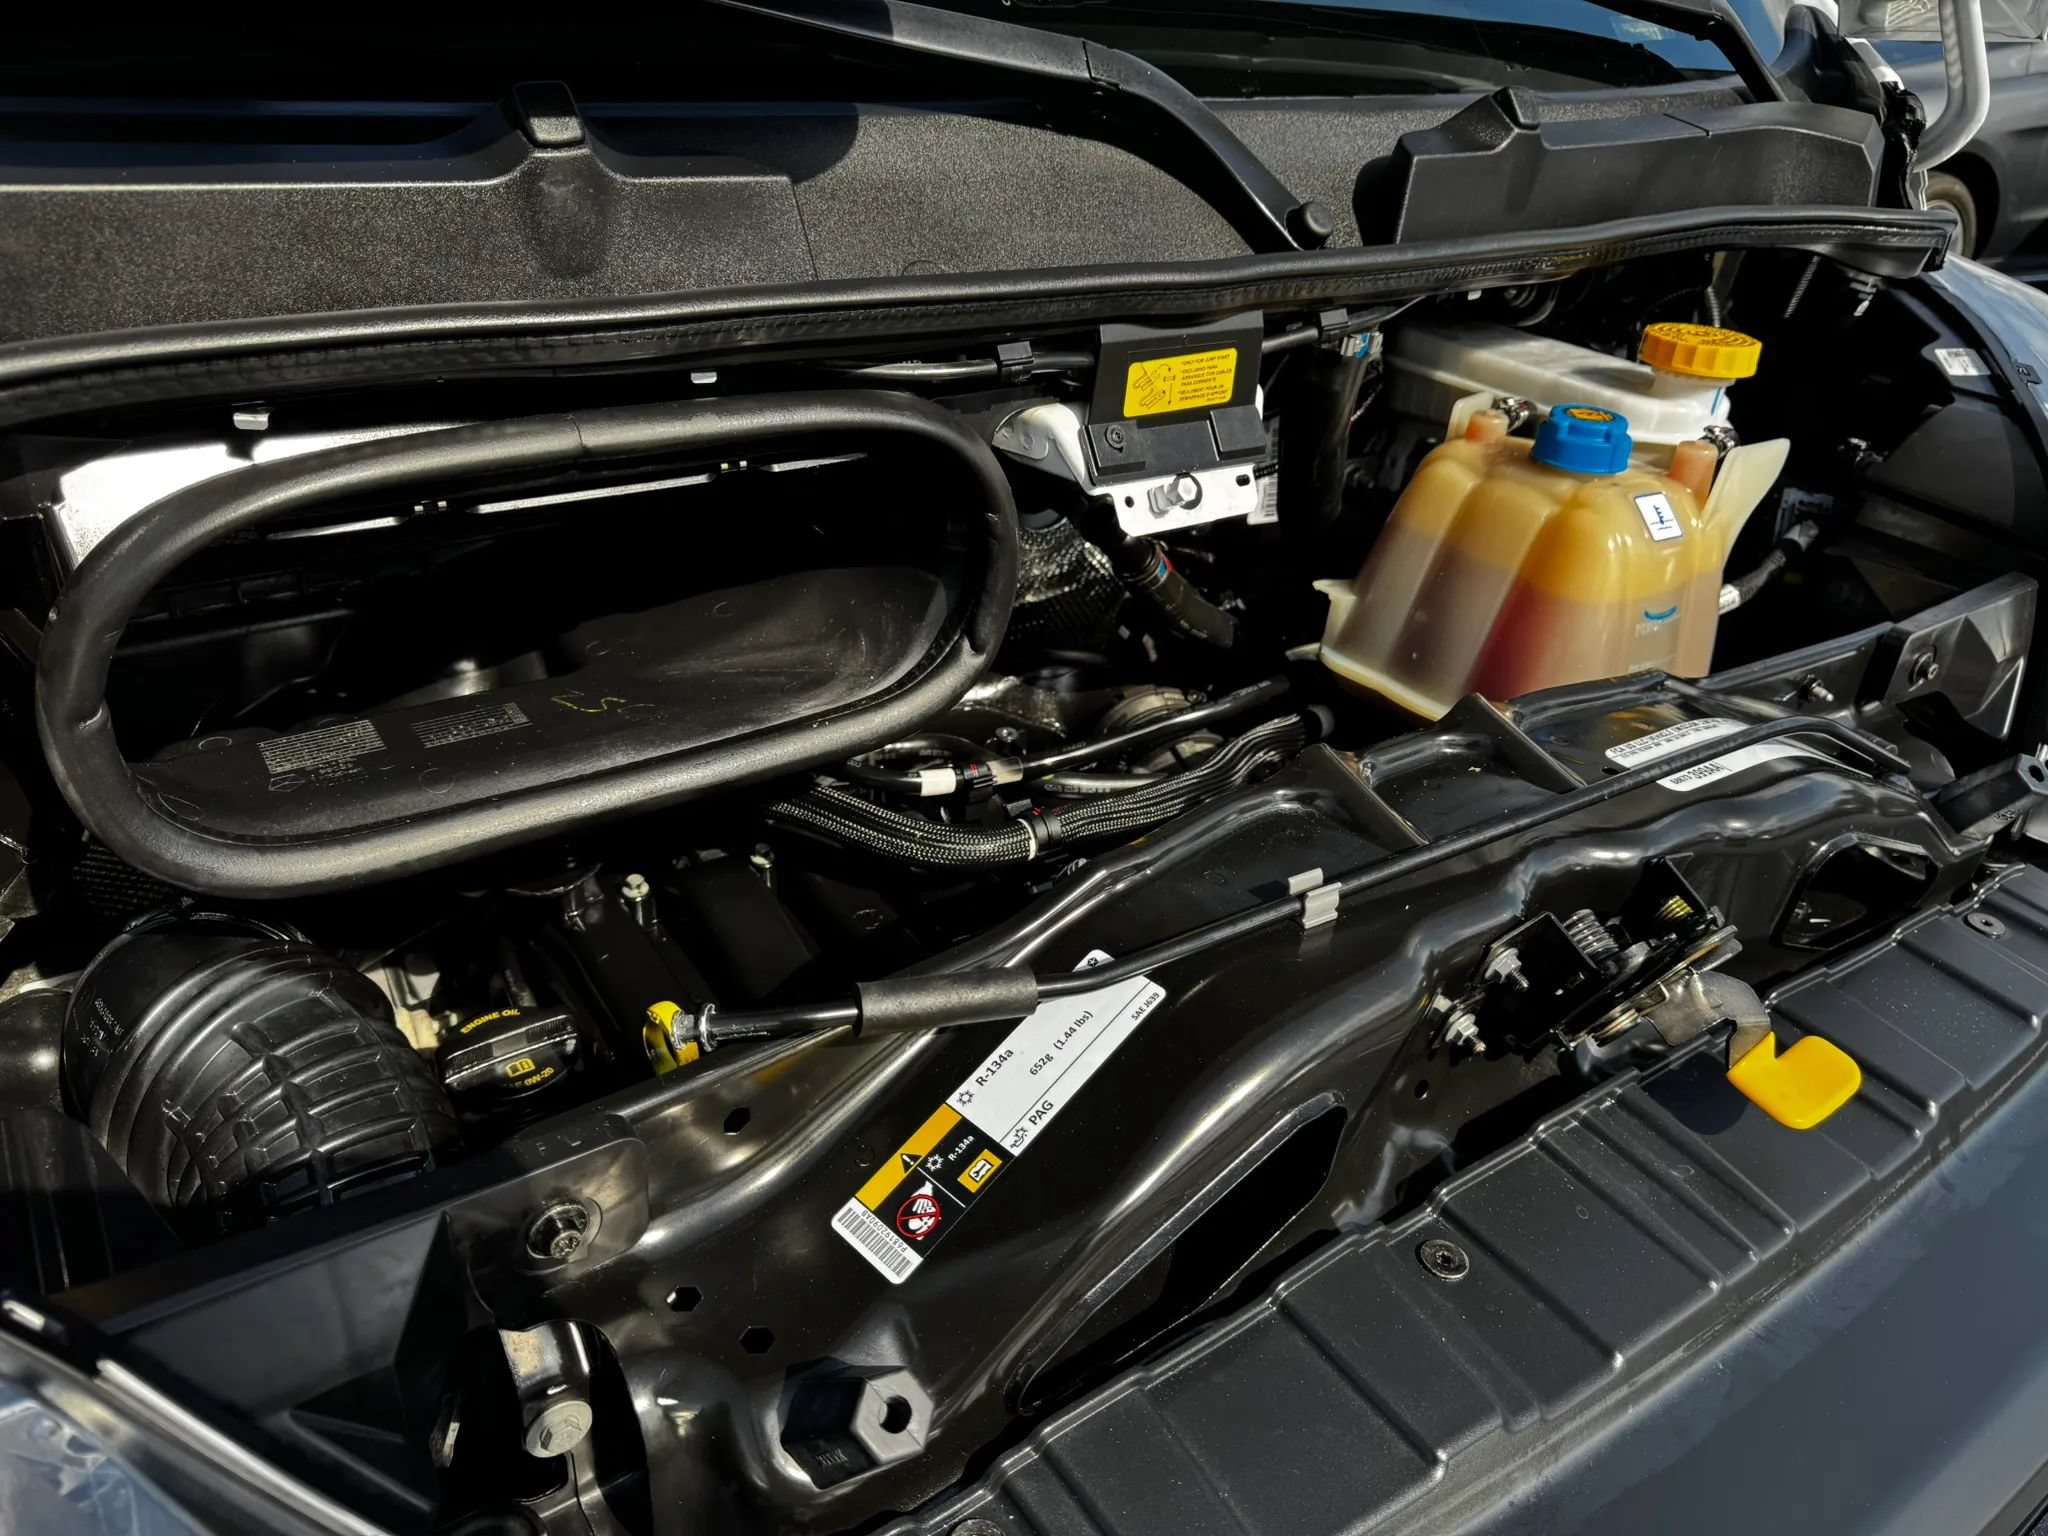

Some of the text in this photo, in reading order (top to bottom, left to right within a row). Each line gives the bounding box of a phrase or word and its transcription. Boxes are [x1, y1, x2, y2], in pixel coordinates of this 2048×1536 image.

[1132, 992, 1160, 1021] SAE J639
[460, 1009, 521, 1034] ENGINE OIL
[1029, 1010, 1094, 1076] 652g (1.44 lbs)
[524, 1067, 555, 1087] 0W-20
[975, 1049, 1014, 1087] R-134a
[1028, 1099, 1054, 1126] PAG
[948, 1135, 975, 1162] R-134a
[860, 1209, 907, 1253] P68192090AB
